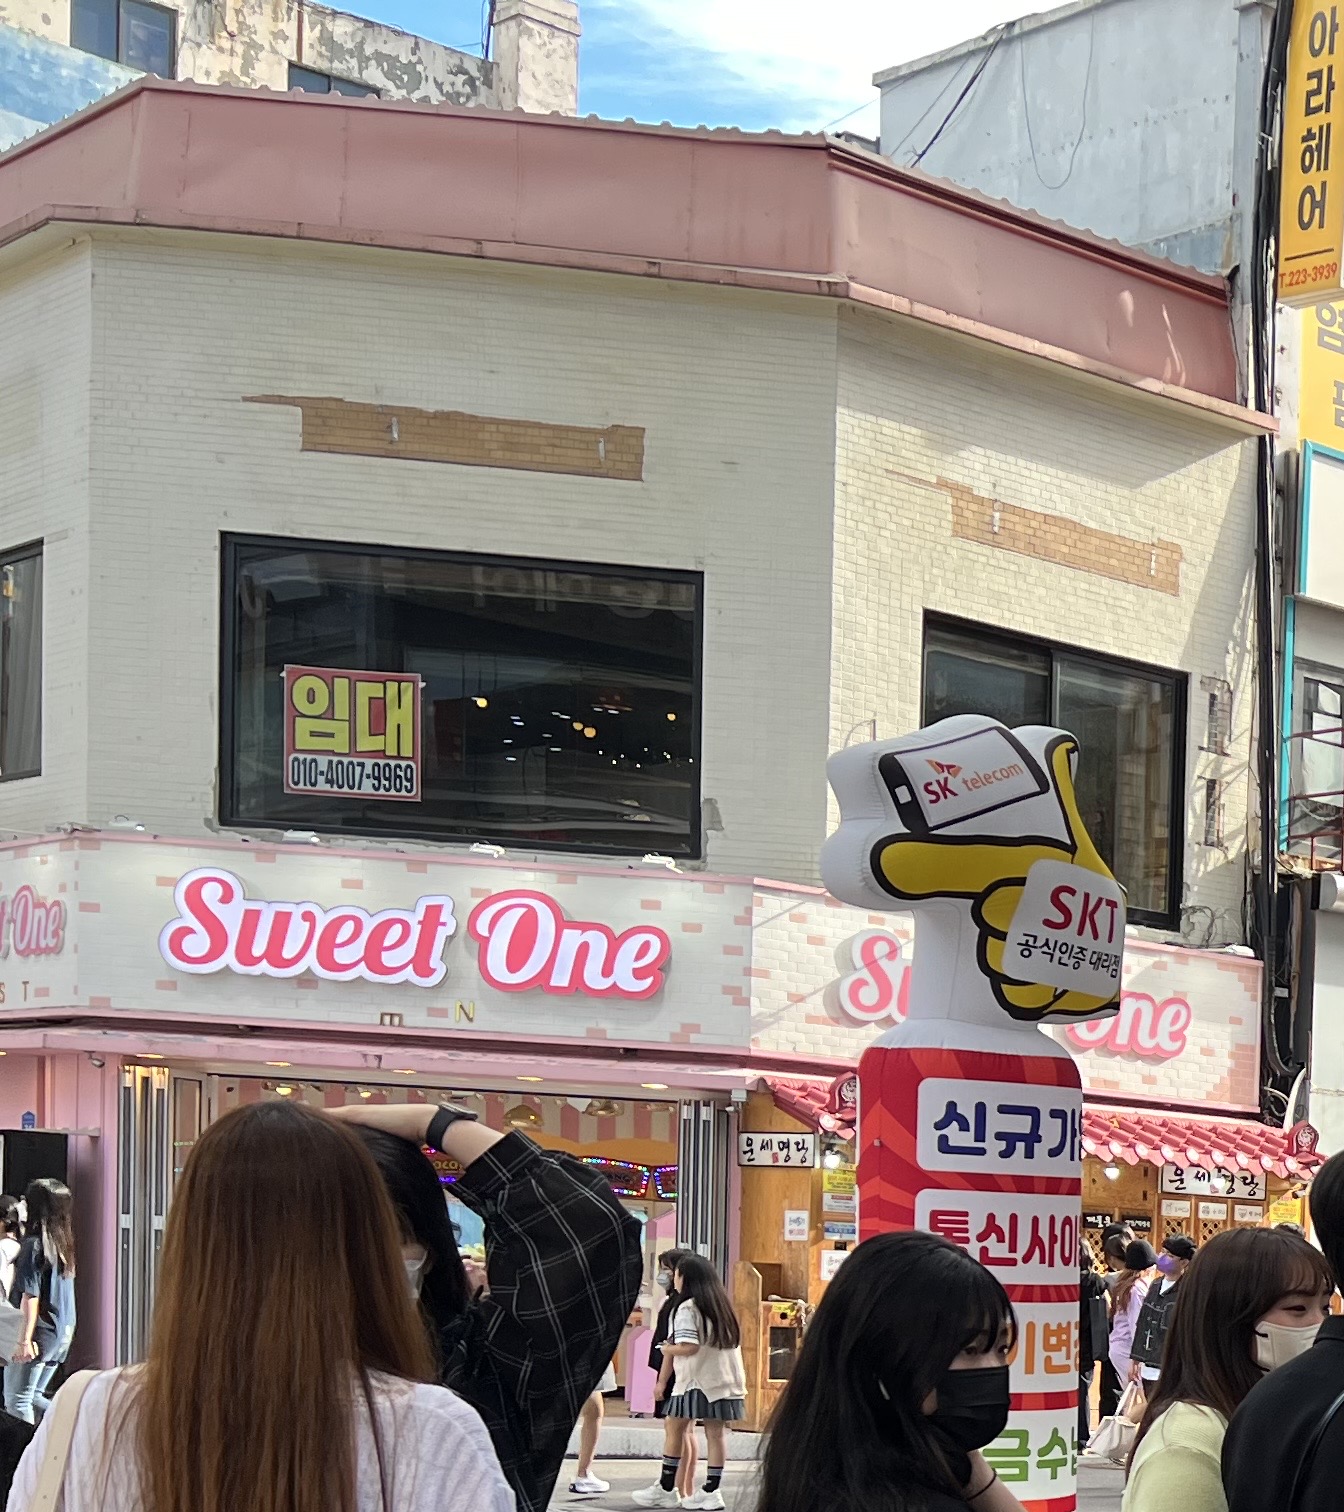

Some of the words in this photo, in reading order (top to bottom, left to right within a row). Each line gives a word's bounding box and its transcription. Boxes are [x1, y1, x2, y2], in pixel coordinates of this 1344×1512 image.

[1298, 6, 1339, 231] 아라헤어
[1279, 262, 1337, 289] T.223-3939
[291, 673, 414, 758] 임대
[290, 755, 415, 795] 010-4007-9969
[924, 776, 959, 804] SK
[961, 762, 1024, 792] telecom
[12, 885, 67, 957] One
[158, 867, 457, 988] Sweet
[467, 889, 672, 998] One
[1042, 885, 1118, 943] SKT
[1017, 932, 1088, 970] 공식인증
[742, 1136, 809, 1164] 운세명당
[933, 1099, 1081, 1163] 신규가
[928, 1208, 1080, 1269] 통신사이
